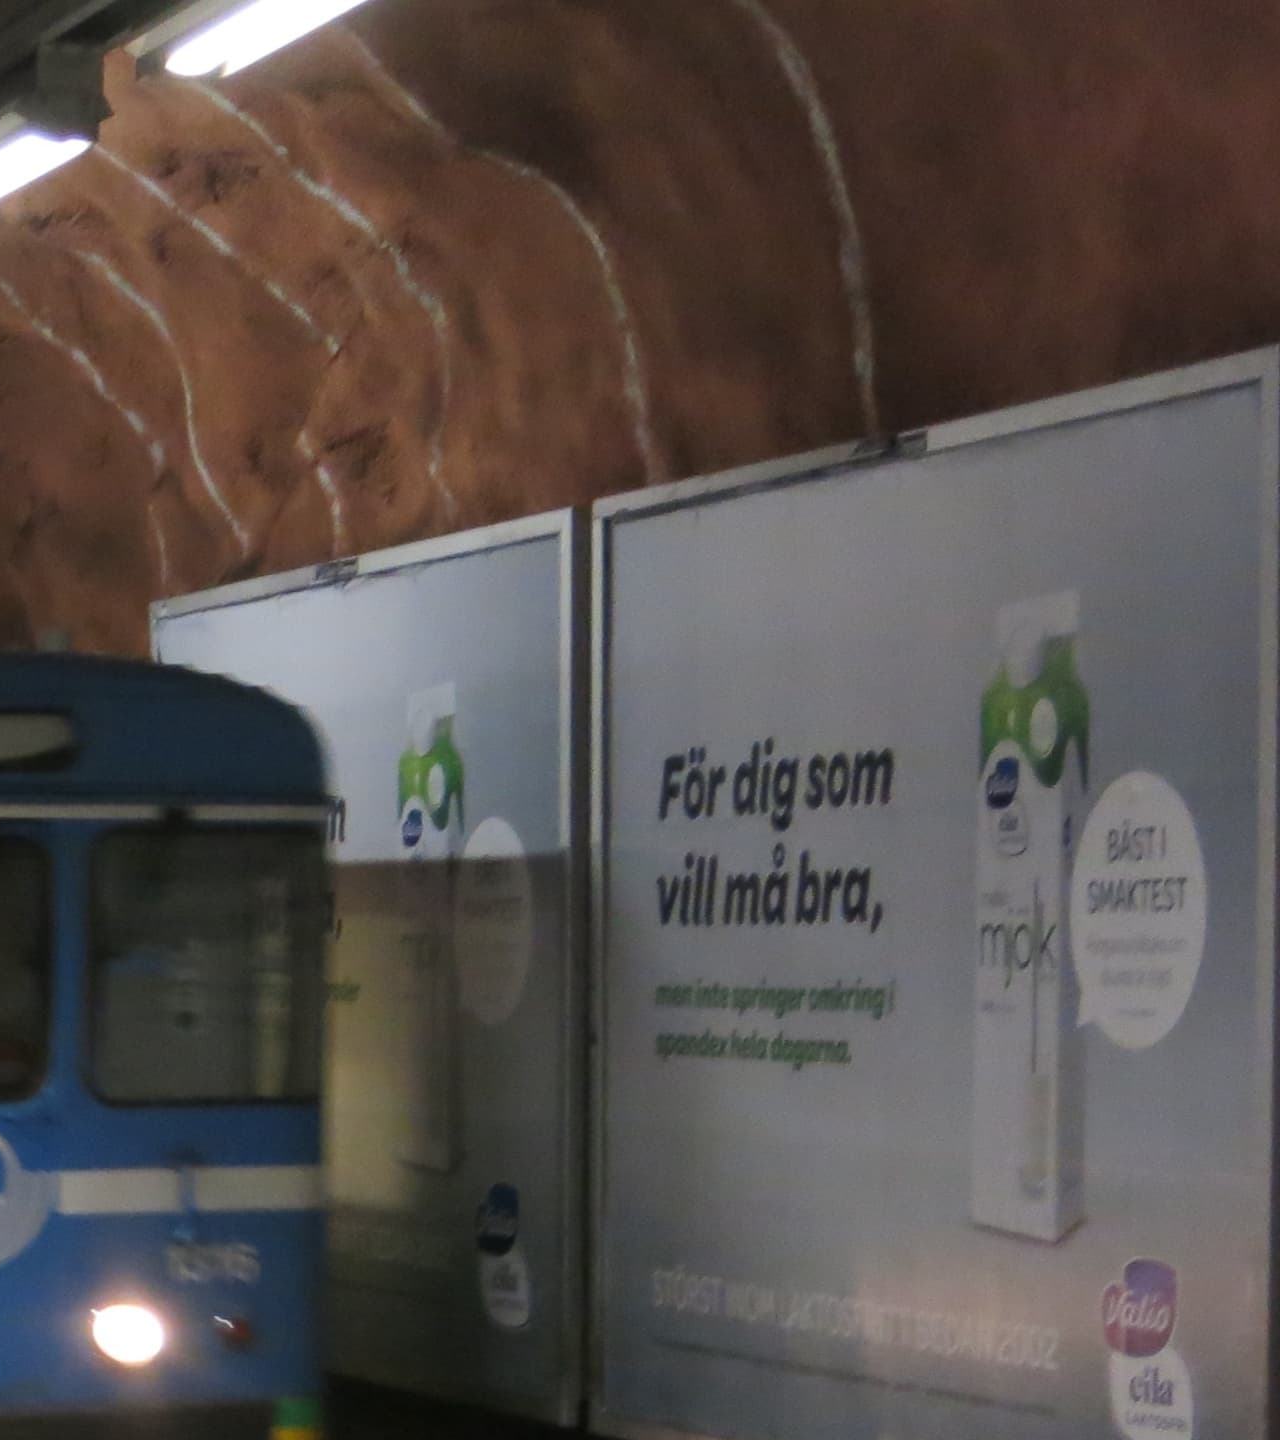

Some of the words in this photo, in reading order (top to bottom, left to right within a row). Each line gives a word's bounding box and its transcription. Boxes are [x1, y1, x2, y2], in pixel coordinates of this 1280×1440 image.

[658, 746, 726, 821] För
[733, 736, 800, 832] dig
[805, 748, 894, 810] som
[1106, 819, 1155, 865] BÄST
[656, 851, 718, 927] vill
[723, 842, 789, 926] må
[794, 849, 884, 934] bra,
[1086, 876, 1189, 915] SMAKTEST
[1103, 1287, 1171, 1334] Valio
